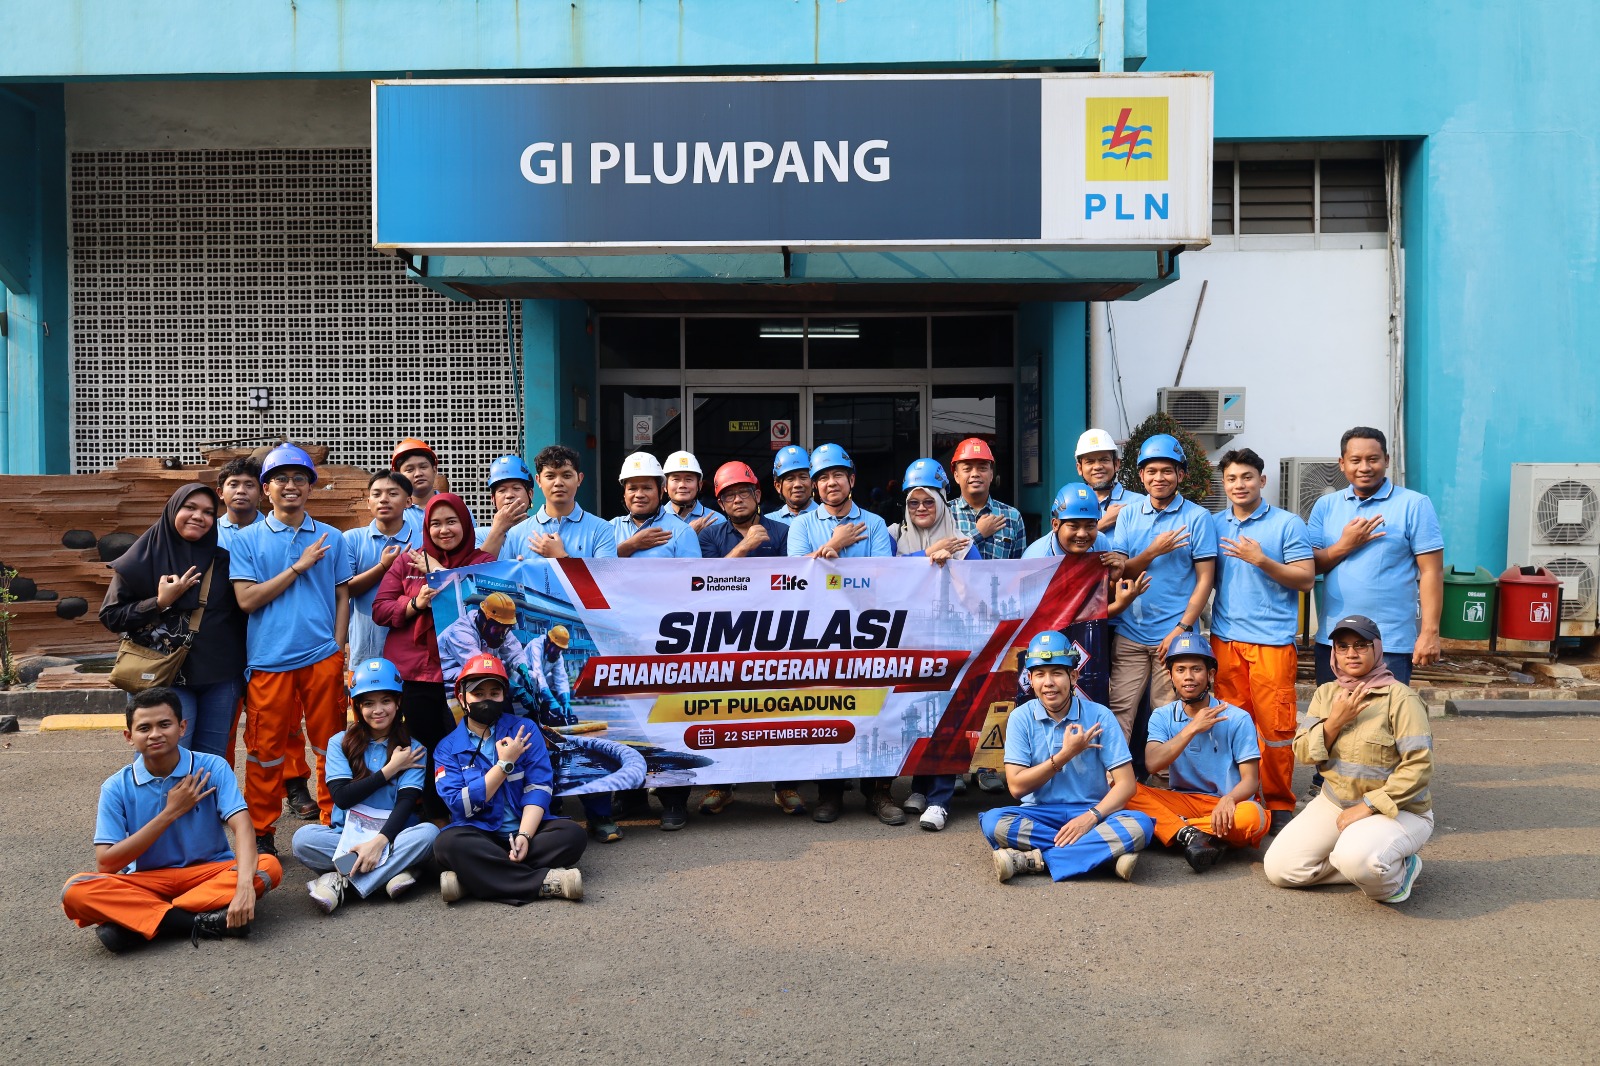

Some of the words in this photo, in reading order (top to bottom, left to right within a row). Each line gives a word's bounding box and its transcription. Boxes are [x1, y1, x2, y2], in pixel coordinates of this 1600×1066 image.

[519, 140, 572, 185] GI
[590, 138, 891, 185] PLUMPANG
[1084, 193, 1169, 220] PLN
[706, 575, 751, 583] Danantara
[843, 577, 871, 589] PLN
[655, 609, 908, 654] SIMULASI
[593, 660, 736, 687] PENANGANAN
[740, 658, 830, 682] CECERAN
[834, 656, 914, 679] LIMBAH
[918, 657, 949, 678] B3
[684, 699, 723, 716] UPT
[727, 695, 856, 714] PULOGADUNG
[724, 731, 738, 742] 22
[741, 728, 808, 741] SEPTEMBER
[811, 727, 839, 738] 2026
